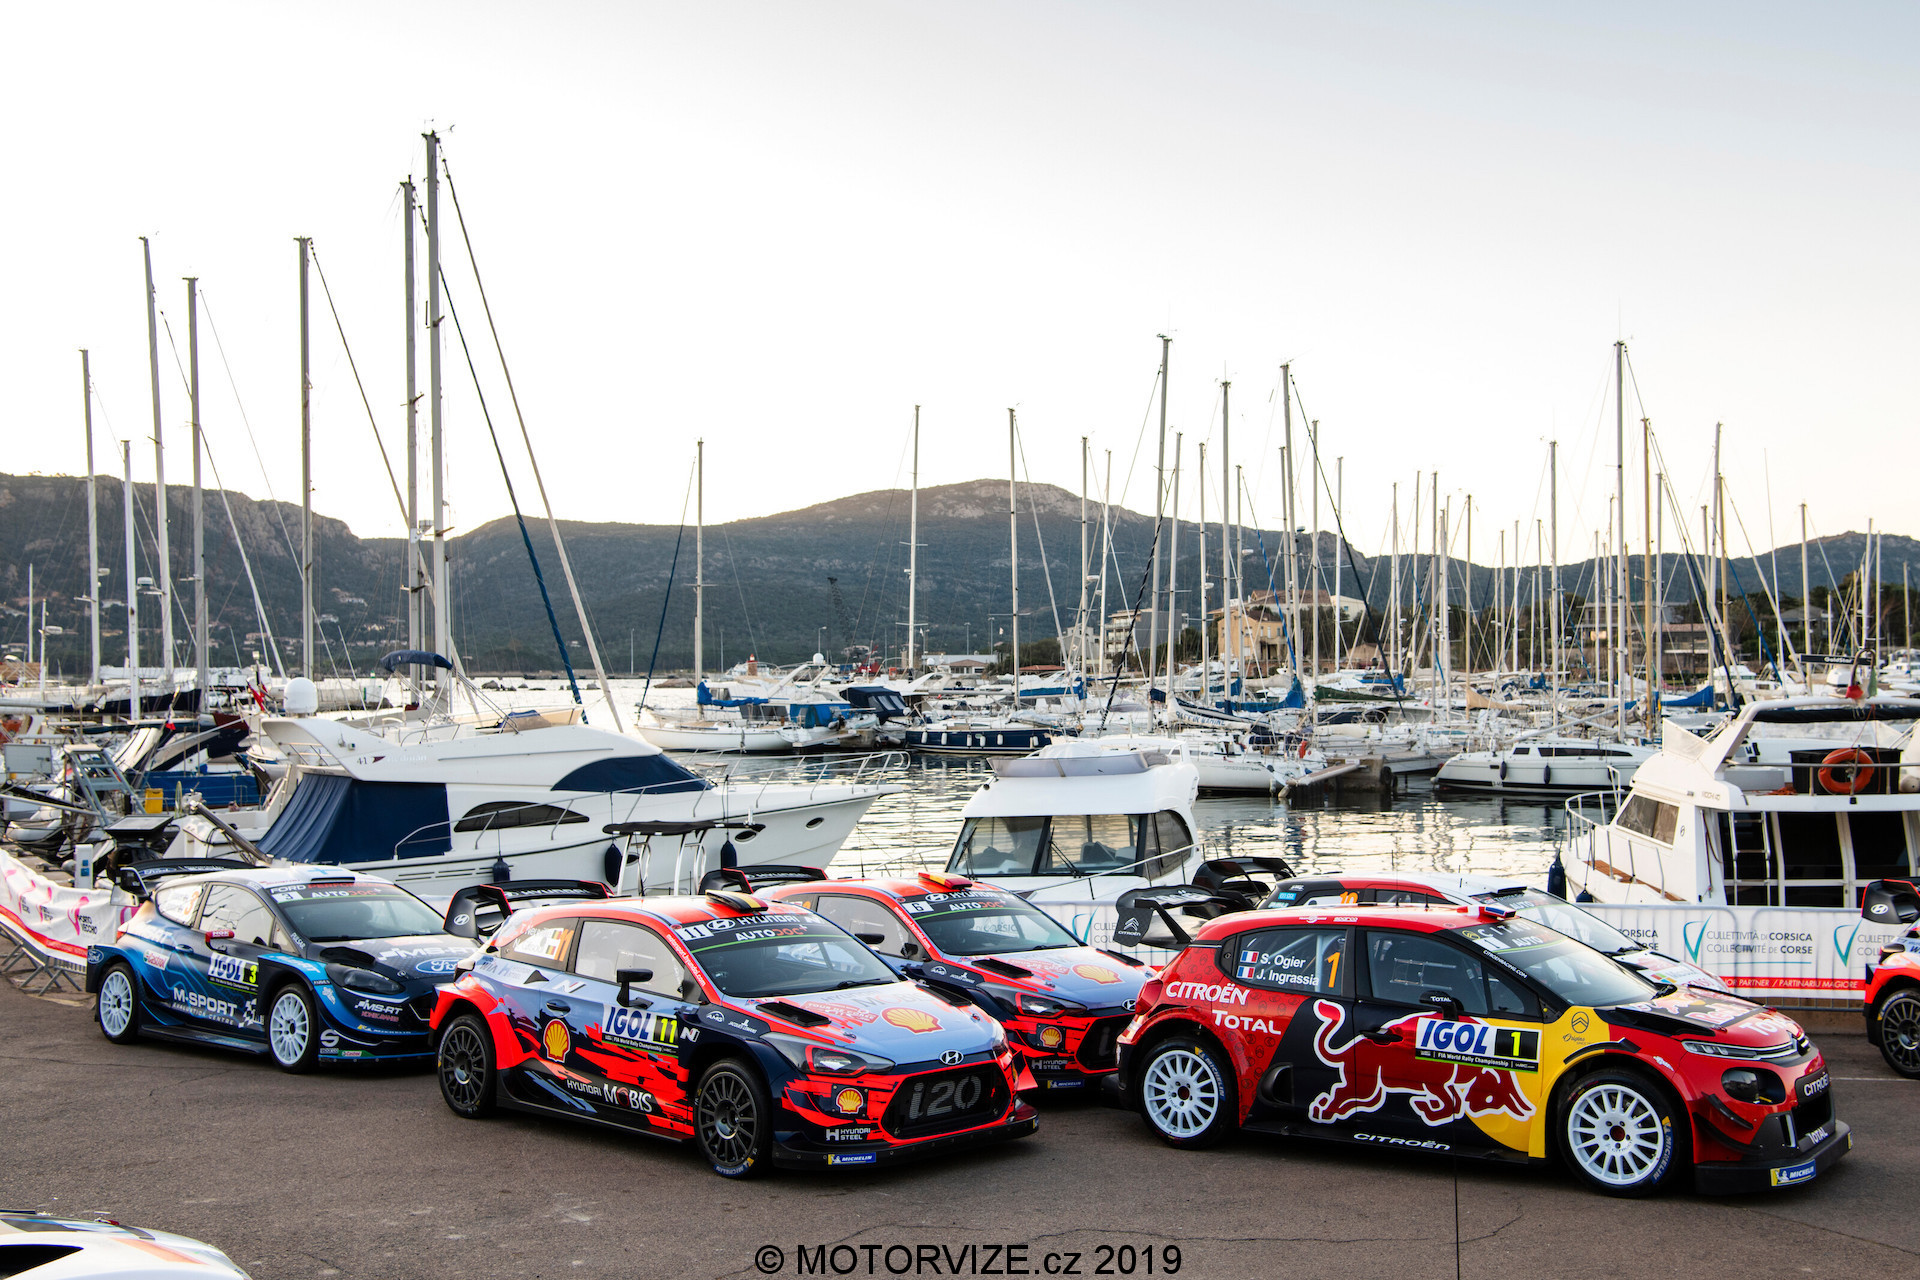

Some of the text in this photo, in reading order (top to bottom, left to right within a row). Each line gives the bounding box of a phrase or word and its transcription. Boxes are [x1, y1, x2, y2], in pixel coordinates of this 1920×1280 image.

[271, 884, 306, 893] FORD
[284, 892, 293, 900] 3
[1339, 890, 1358, 904] 10
[184, 891, 199, 915] 3
[915, 903, 924, 911] 6
[949, 891, 1000, 899] HYUNDAI
[683, 927, 706, 939] 11
[737, 915, 800, 925] HYUNDAI
[1706, 930, 1760, 940] CULLETTIVITÀ
[1769, 932, 1813, 942] CORSICA
[554, 929, 574, 961] 11
[1706, 943, 1813, 954] COLLECTIVITÉ DE CORSE
[210, 954, 243, 981] IGOL
[249, 964, 258, 984] 3
[665, 933, 706, 987] motorsport.hyundai.com
[1260, 953, 1306, 969] S. Ogier
[1327, 952, 1341, 988] 1
[1256, 969, 1319, 986] J. Ingrassia
[1739, 979, 1769, 987] PARTNER
[1778, 979, 1821, 988] PARTINARIU
[1822, 980, 1859, 989] MAGIORE
[1166, 981, 1251, 1005] CITROËN
[208, 1013, 234, 1026] CENTRE
[605, 1006, 678, 1043] IGOL 11
[1212, 1009, 1282, 1035] TOTAL
[639, 1042, 662, 1052] Championship
[1420, 1020, 1521, 1057] IGOL 1
[1447, 1053, 1461, 1061] World
[1461, 1055, 1474, 1063] Rally
[1474, 1057, 1509, 1067] Championship
[1204, 1057, 1225, 1097] MICHELIN
[566, 1079, 652, 1113] HYUNDAI MOBIS
[909, 1075, 982, 1120] i20
[1805, 1126, 1829, 1145] TOTAL
[1653, 1135, 1672, 1181] MICHELIN
[1789, 1166, 1815, 1179] MICHELIN
